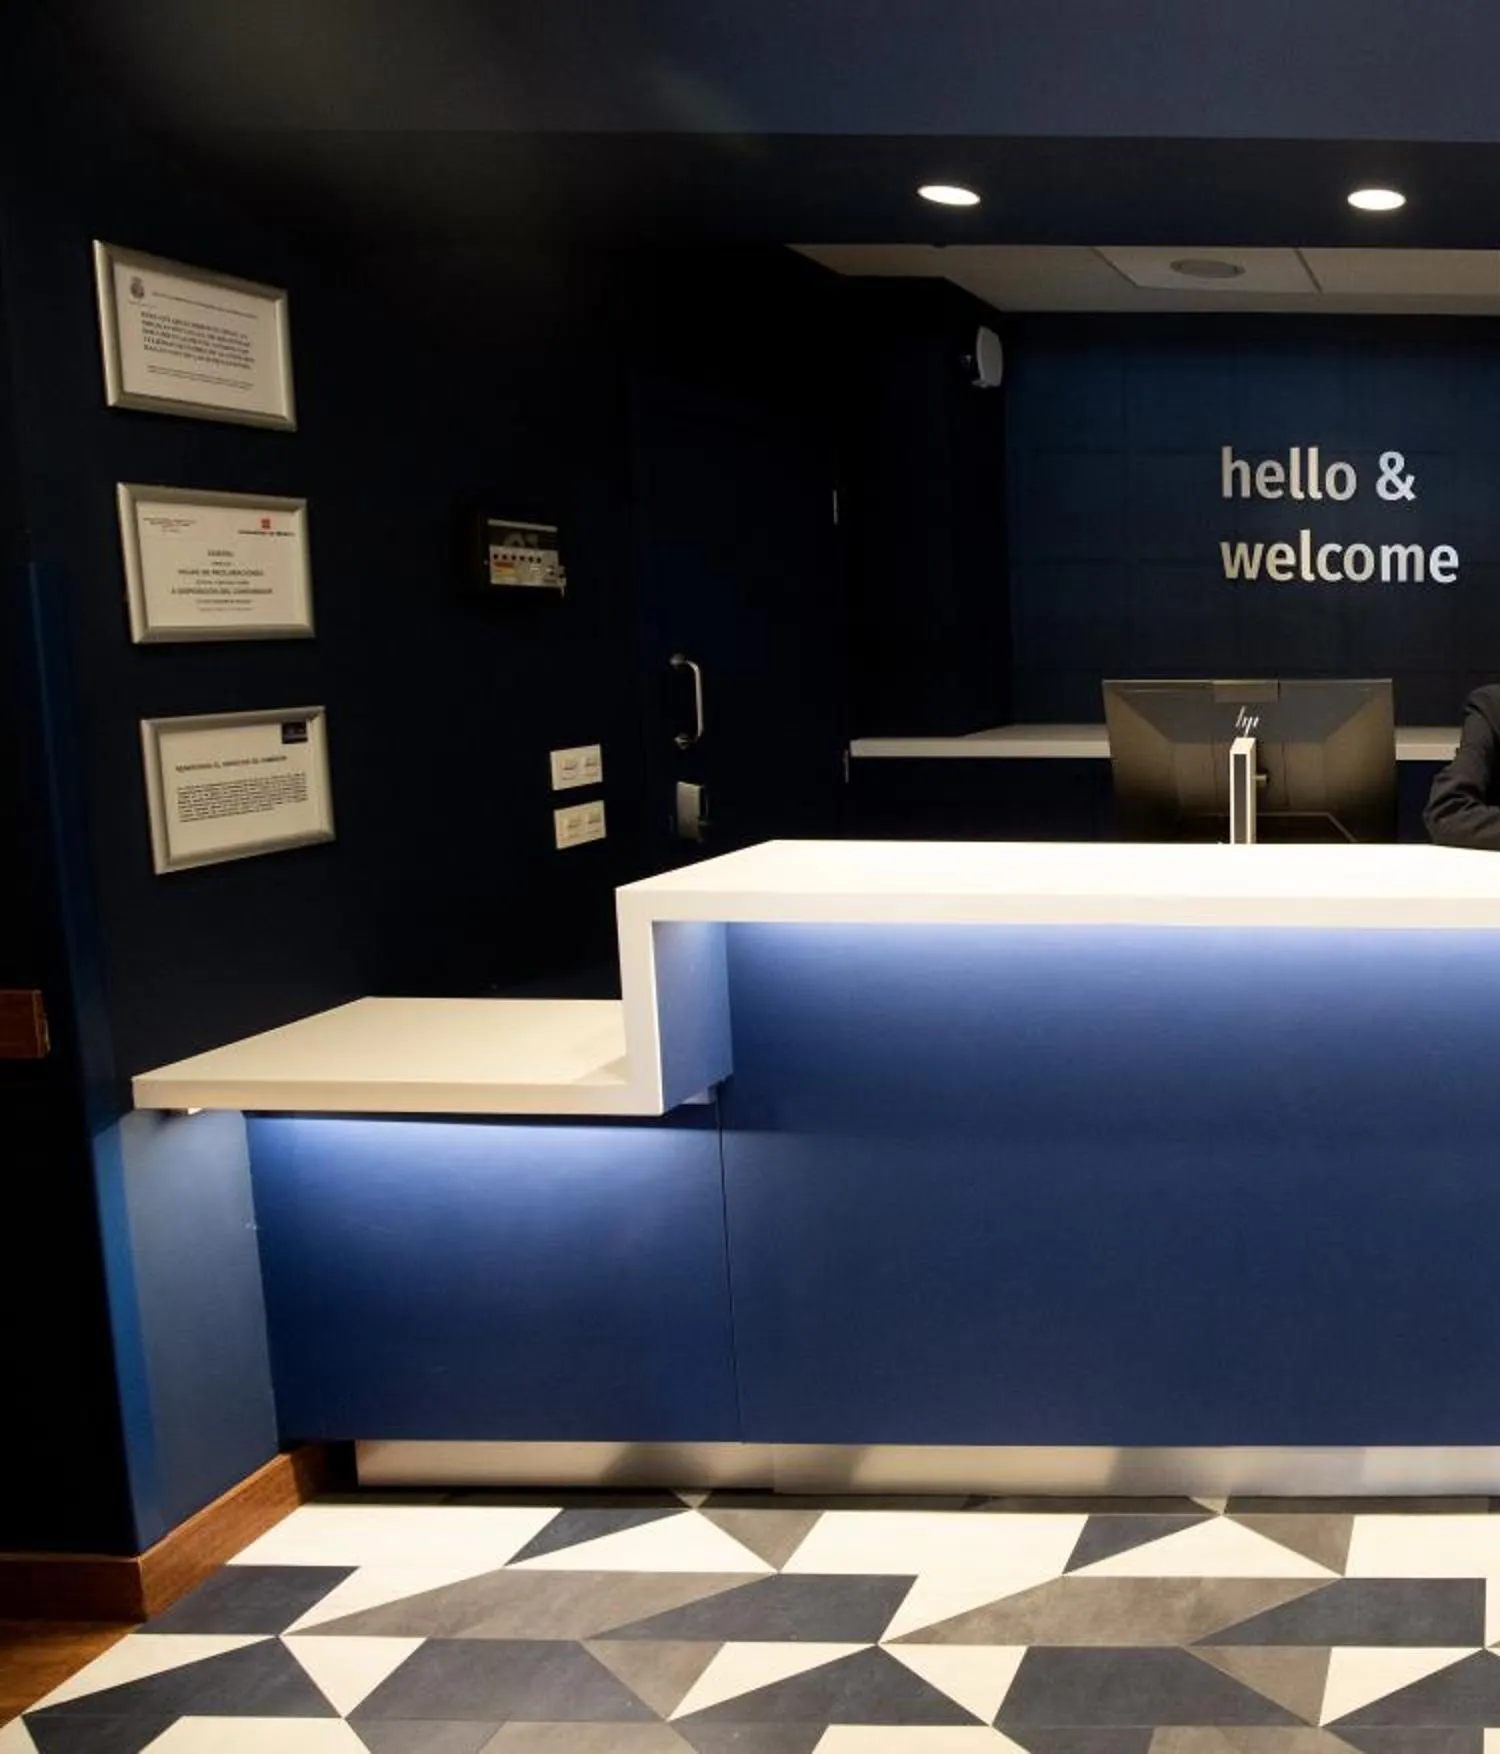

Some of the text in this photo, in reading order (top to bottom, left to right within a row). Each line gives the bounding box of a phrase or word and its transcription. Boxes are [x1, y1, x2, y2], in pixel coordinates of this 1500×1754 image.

[1220, 446, 1417, 501] hello &
[1218, 528, 1460, 584] welcome
